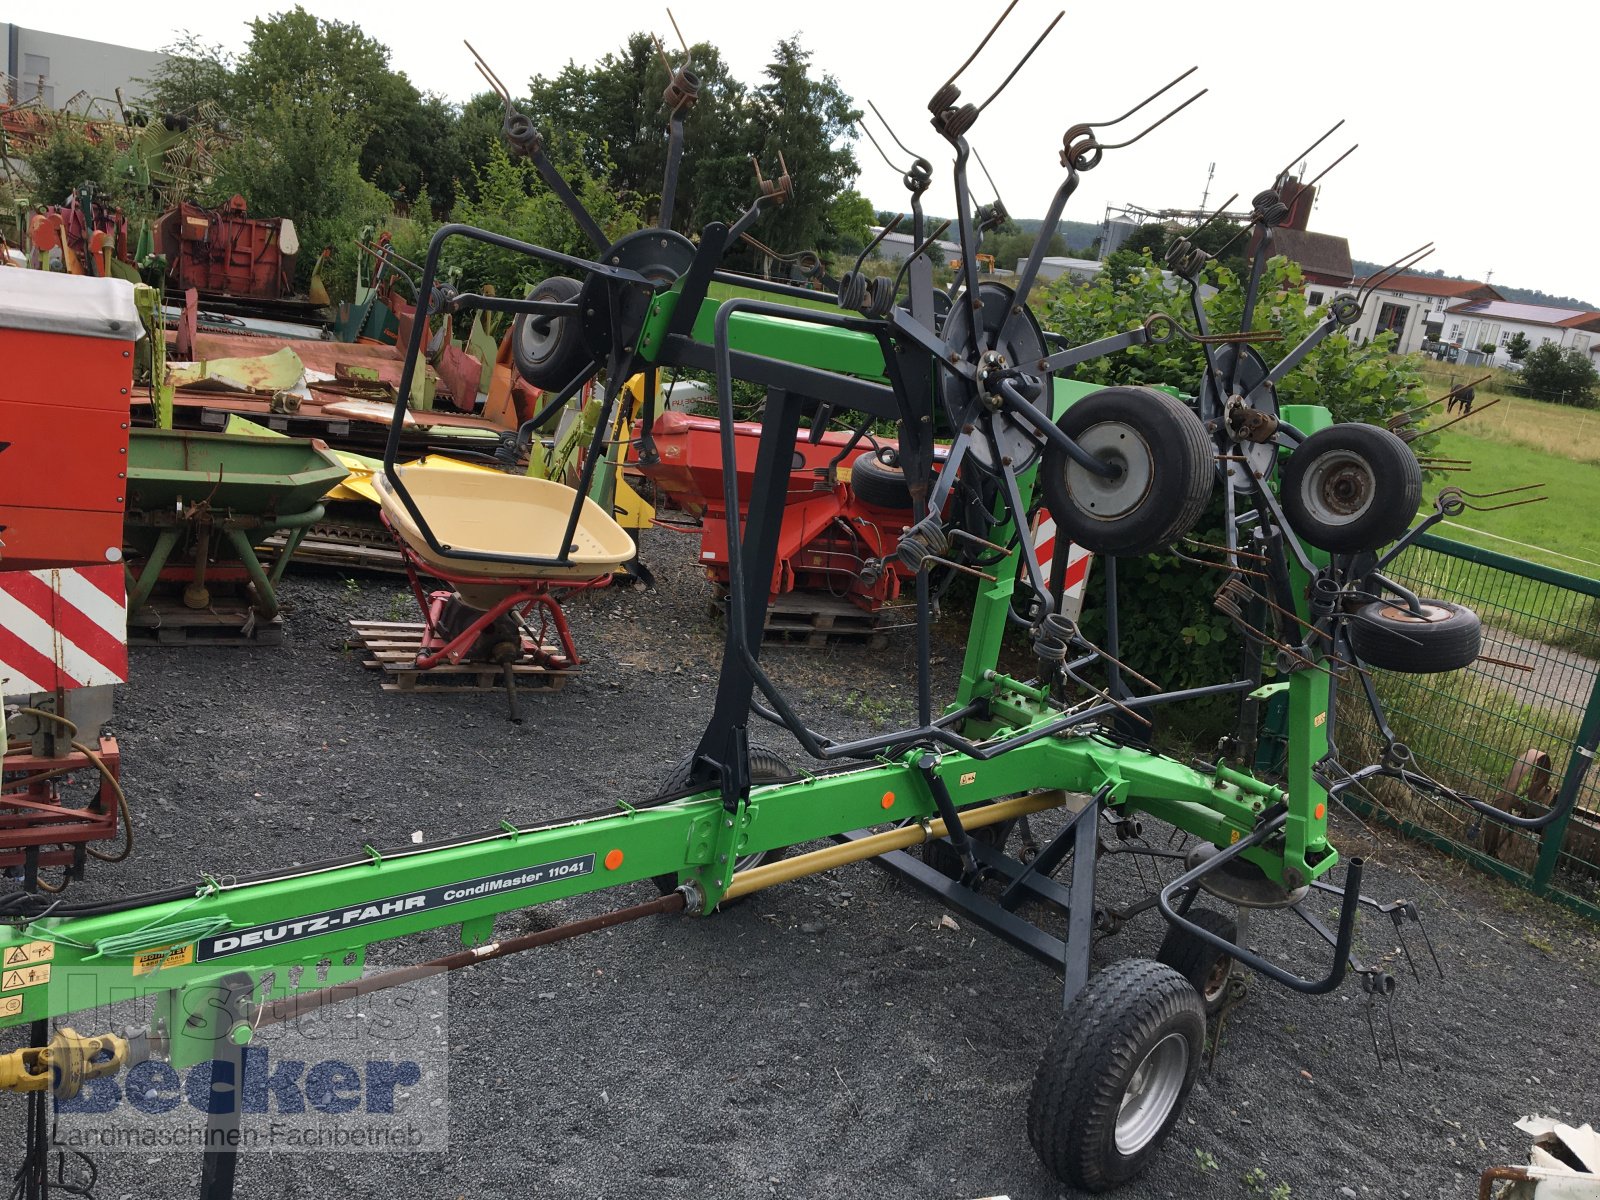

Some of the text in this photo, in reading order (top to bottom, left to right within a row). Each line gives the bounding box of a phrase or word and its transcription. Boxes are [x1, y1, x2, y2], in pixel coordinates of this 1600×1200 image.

[213, 861, 585, 954] DEUTZ-FAHR CondiMaster 11041
